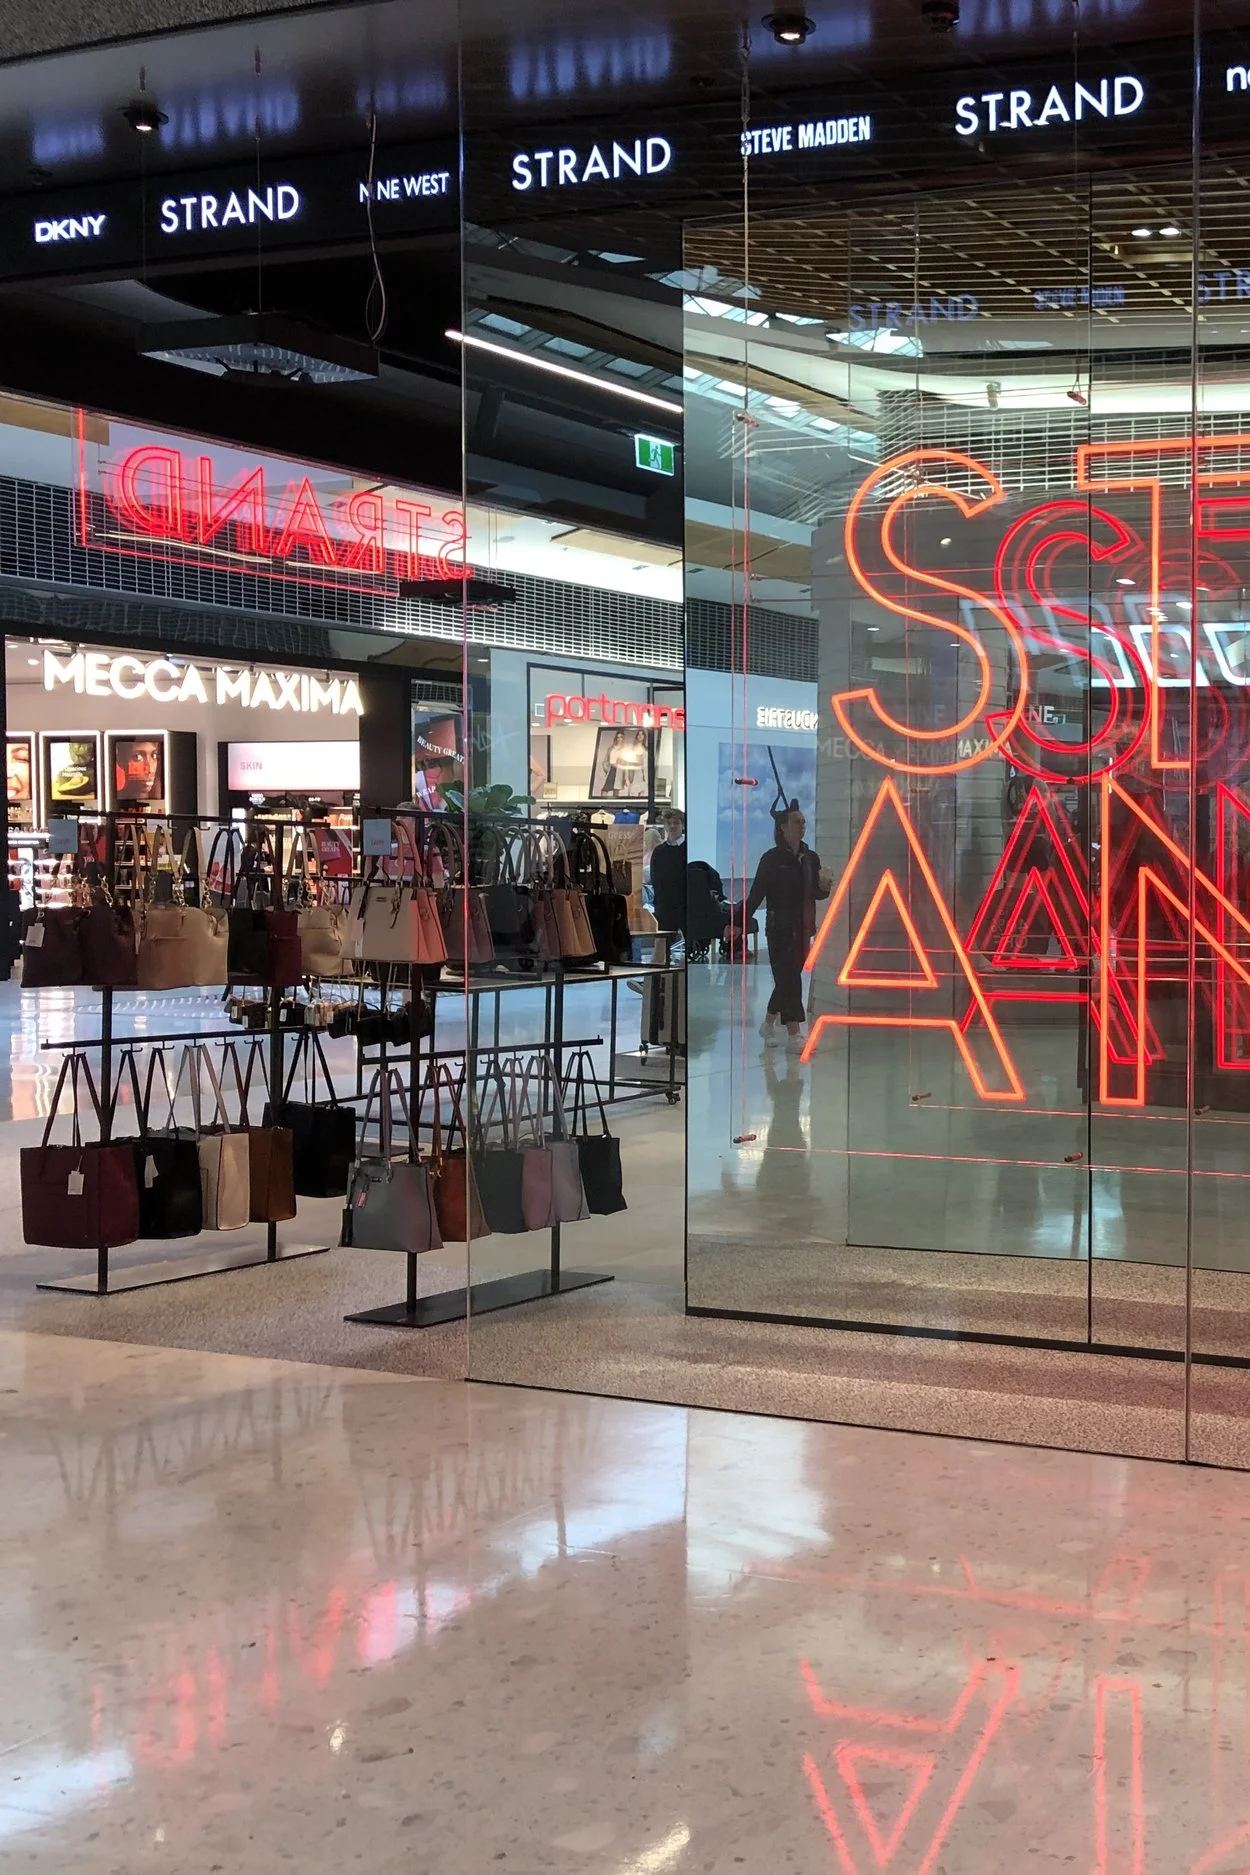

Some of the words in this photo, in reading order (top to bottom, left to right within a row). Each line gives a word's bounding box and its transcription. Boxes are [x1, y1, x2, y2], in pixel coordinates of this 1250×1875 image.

[955, 75, 1145, 136] STRAND
[740, 126, 793, 156] STEVE
[798, 115, 871, 149] MADDEN
[512, 137, 672, 191] STRAND
[359, 179, 400, 203] NNE
[403, 172, 450, 197] WEST
[160, 184, 300, 233] STRAND
[34, 214, 106, 243] DKNY
[848, 293, 979, 332] STRAND
[43, 649, 208, 703] MECCA
[216, 667, 365, 716] MAXIMA
[545, 692, 686, 732] portmans
[240, 761, 263, 770] SKIN
[417, 735, 442, 754] BEAUTY
[443, 747, 466, 765] GREAT
[608, 830, 633, 841] GUESS
